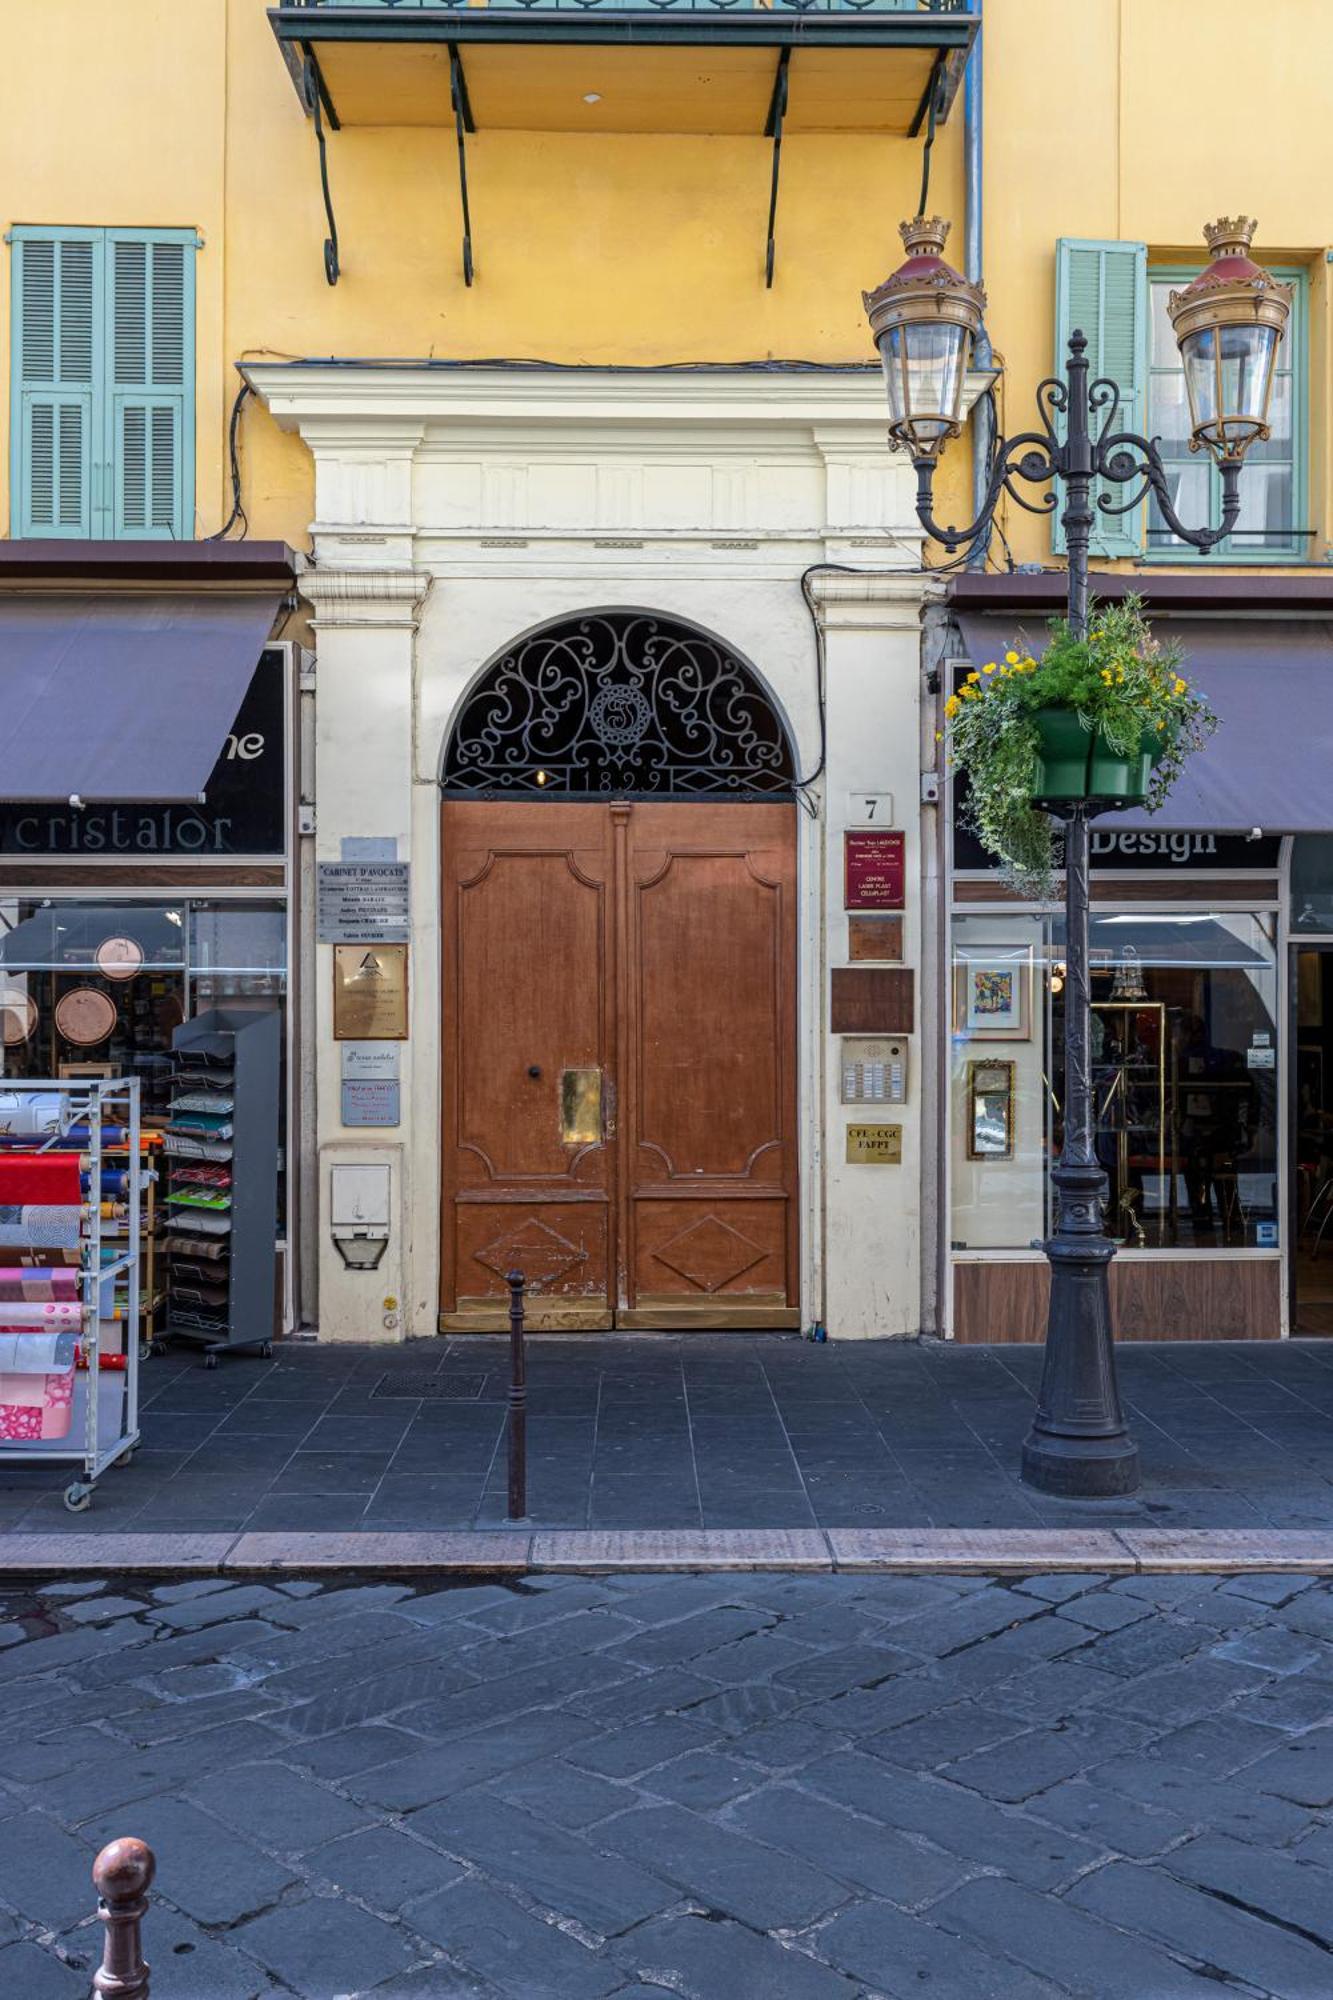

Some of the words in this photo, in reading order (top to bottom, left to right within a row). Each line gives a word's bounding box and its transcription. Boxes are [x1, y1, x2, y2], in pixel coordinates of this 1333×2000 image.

[584, 770, 661, 792] 1829
[865, 799, 877, 820] 7
[15, 808, 232, 849] cristalor
[1090, 832, 1217, 862] Design
[323, 867, 357, 877] CABINET
[360, 867, 404, 877] D'AVOCATS
